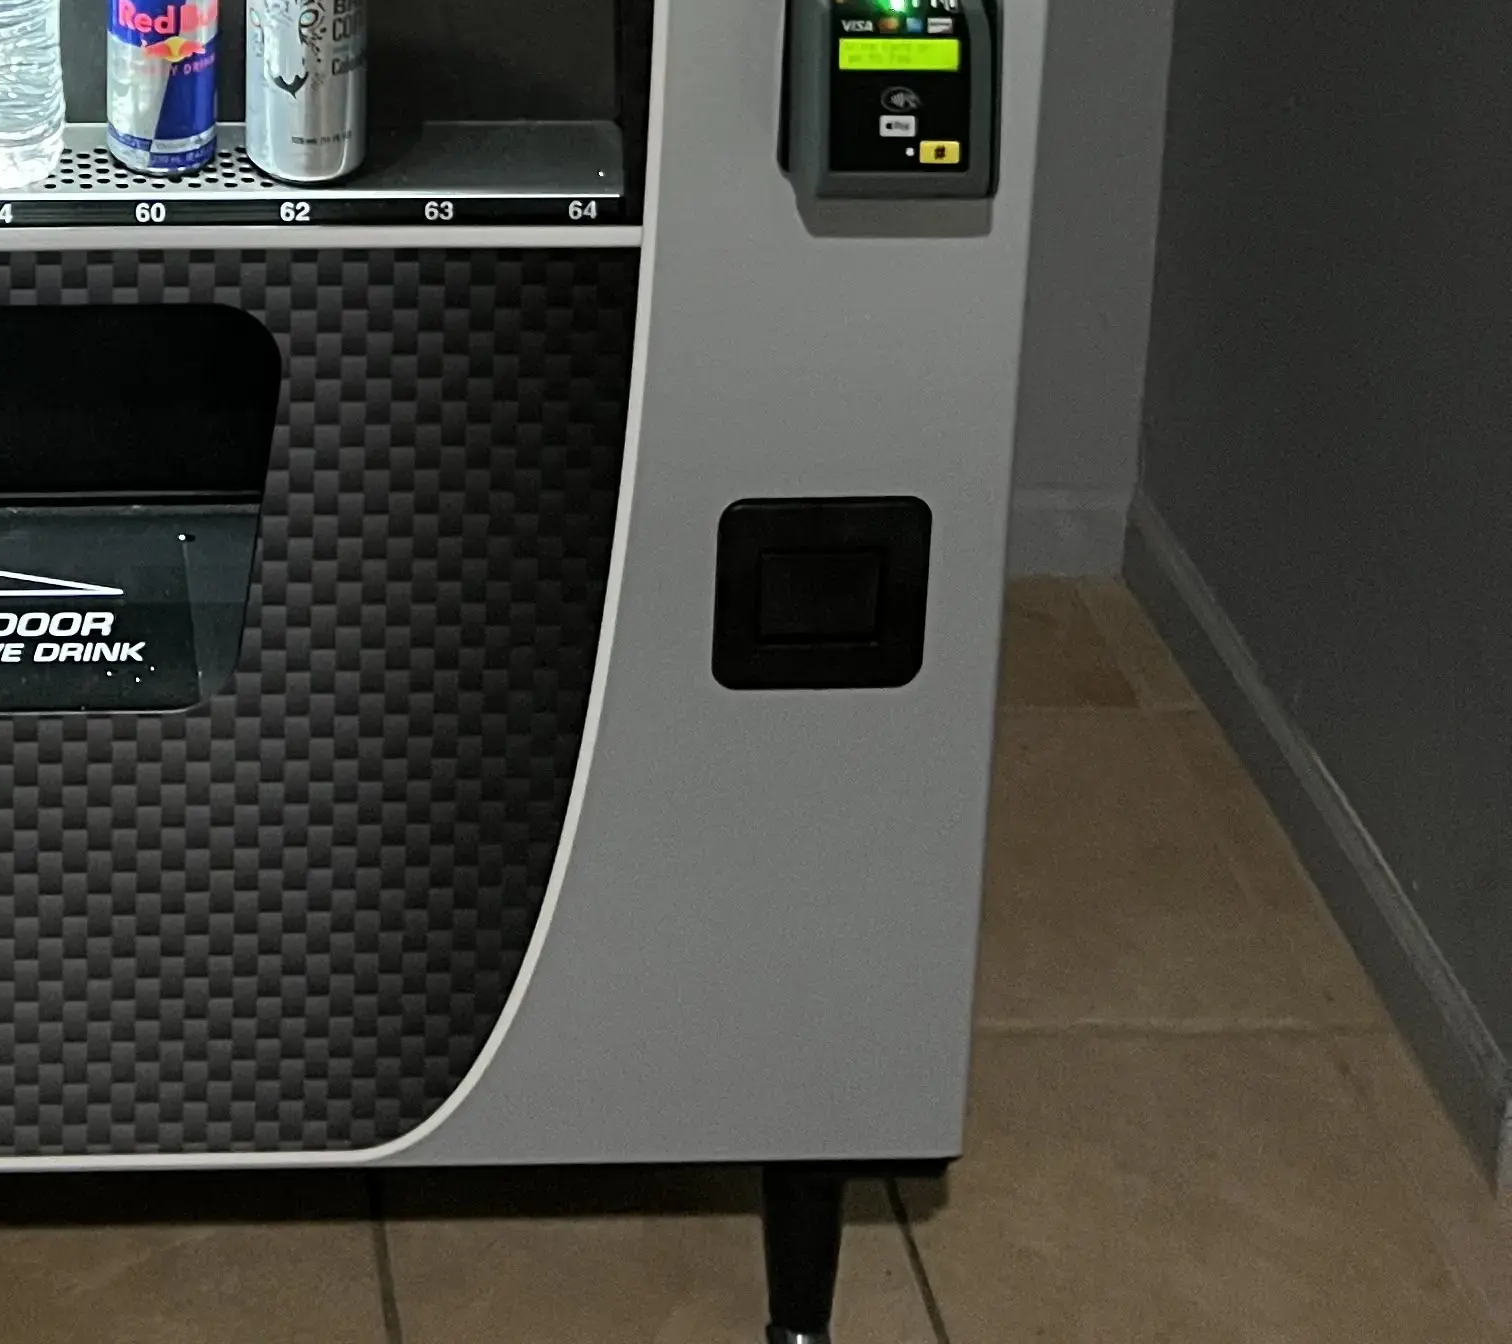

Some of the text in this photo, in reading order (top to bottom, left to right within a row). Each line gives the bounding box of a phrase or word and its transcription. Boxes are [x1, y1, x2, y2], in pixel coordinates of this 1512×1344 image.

[841, 20, 873, 32] VISA
[135, 203, 166, 222] 60
[280, 202, 310, 222] 62
[425, 201, 454, 220] 63
[568, 200, 598, 220] 64
[34, 641, 147, 662] DRINK
